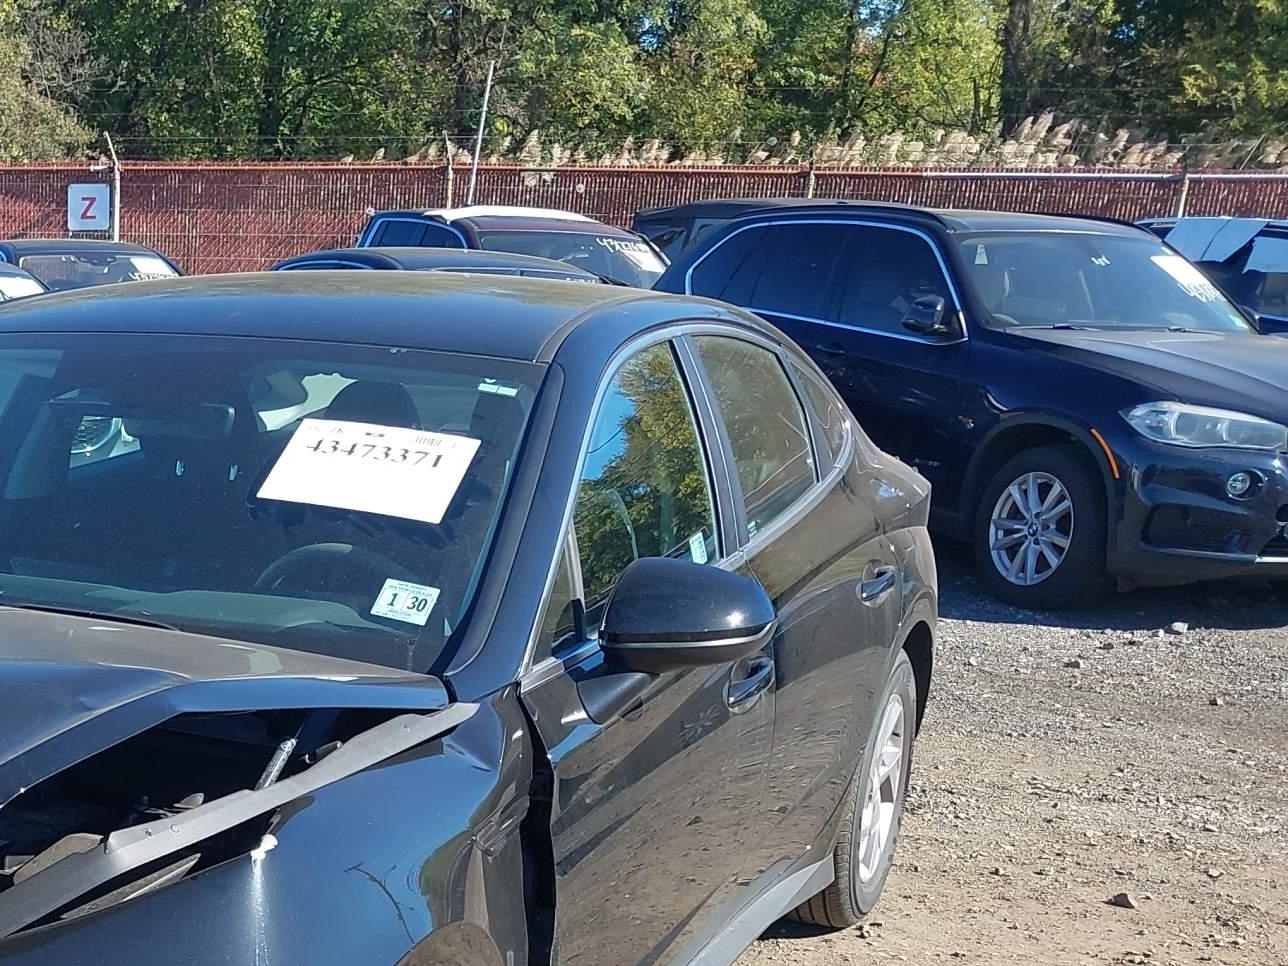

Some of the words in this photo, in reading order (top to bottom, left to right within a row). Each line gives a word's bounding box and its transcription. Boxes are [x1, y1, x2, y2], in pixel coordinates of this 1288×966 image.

[80, 196, 97, 220] Z
[306, 438, 444, 468] 43473371
[386, 592, 399, 607] 1
[406, 595, 428, 612] 30
